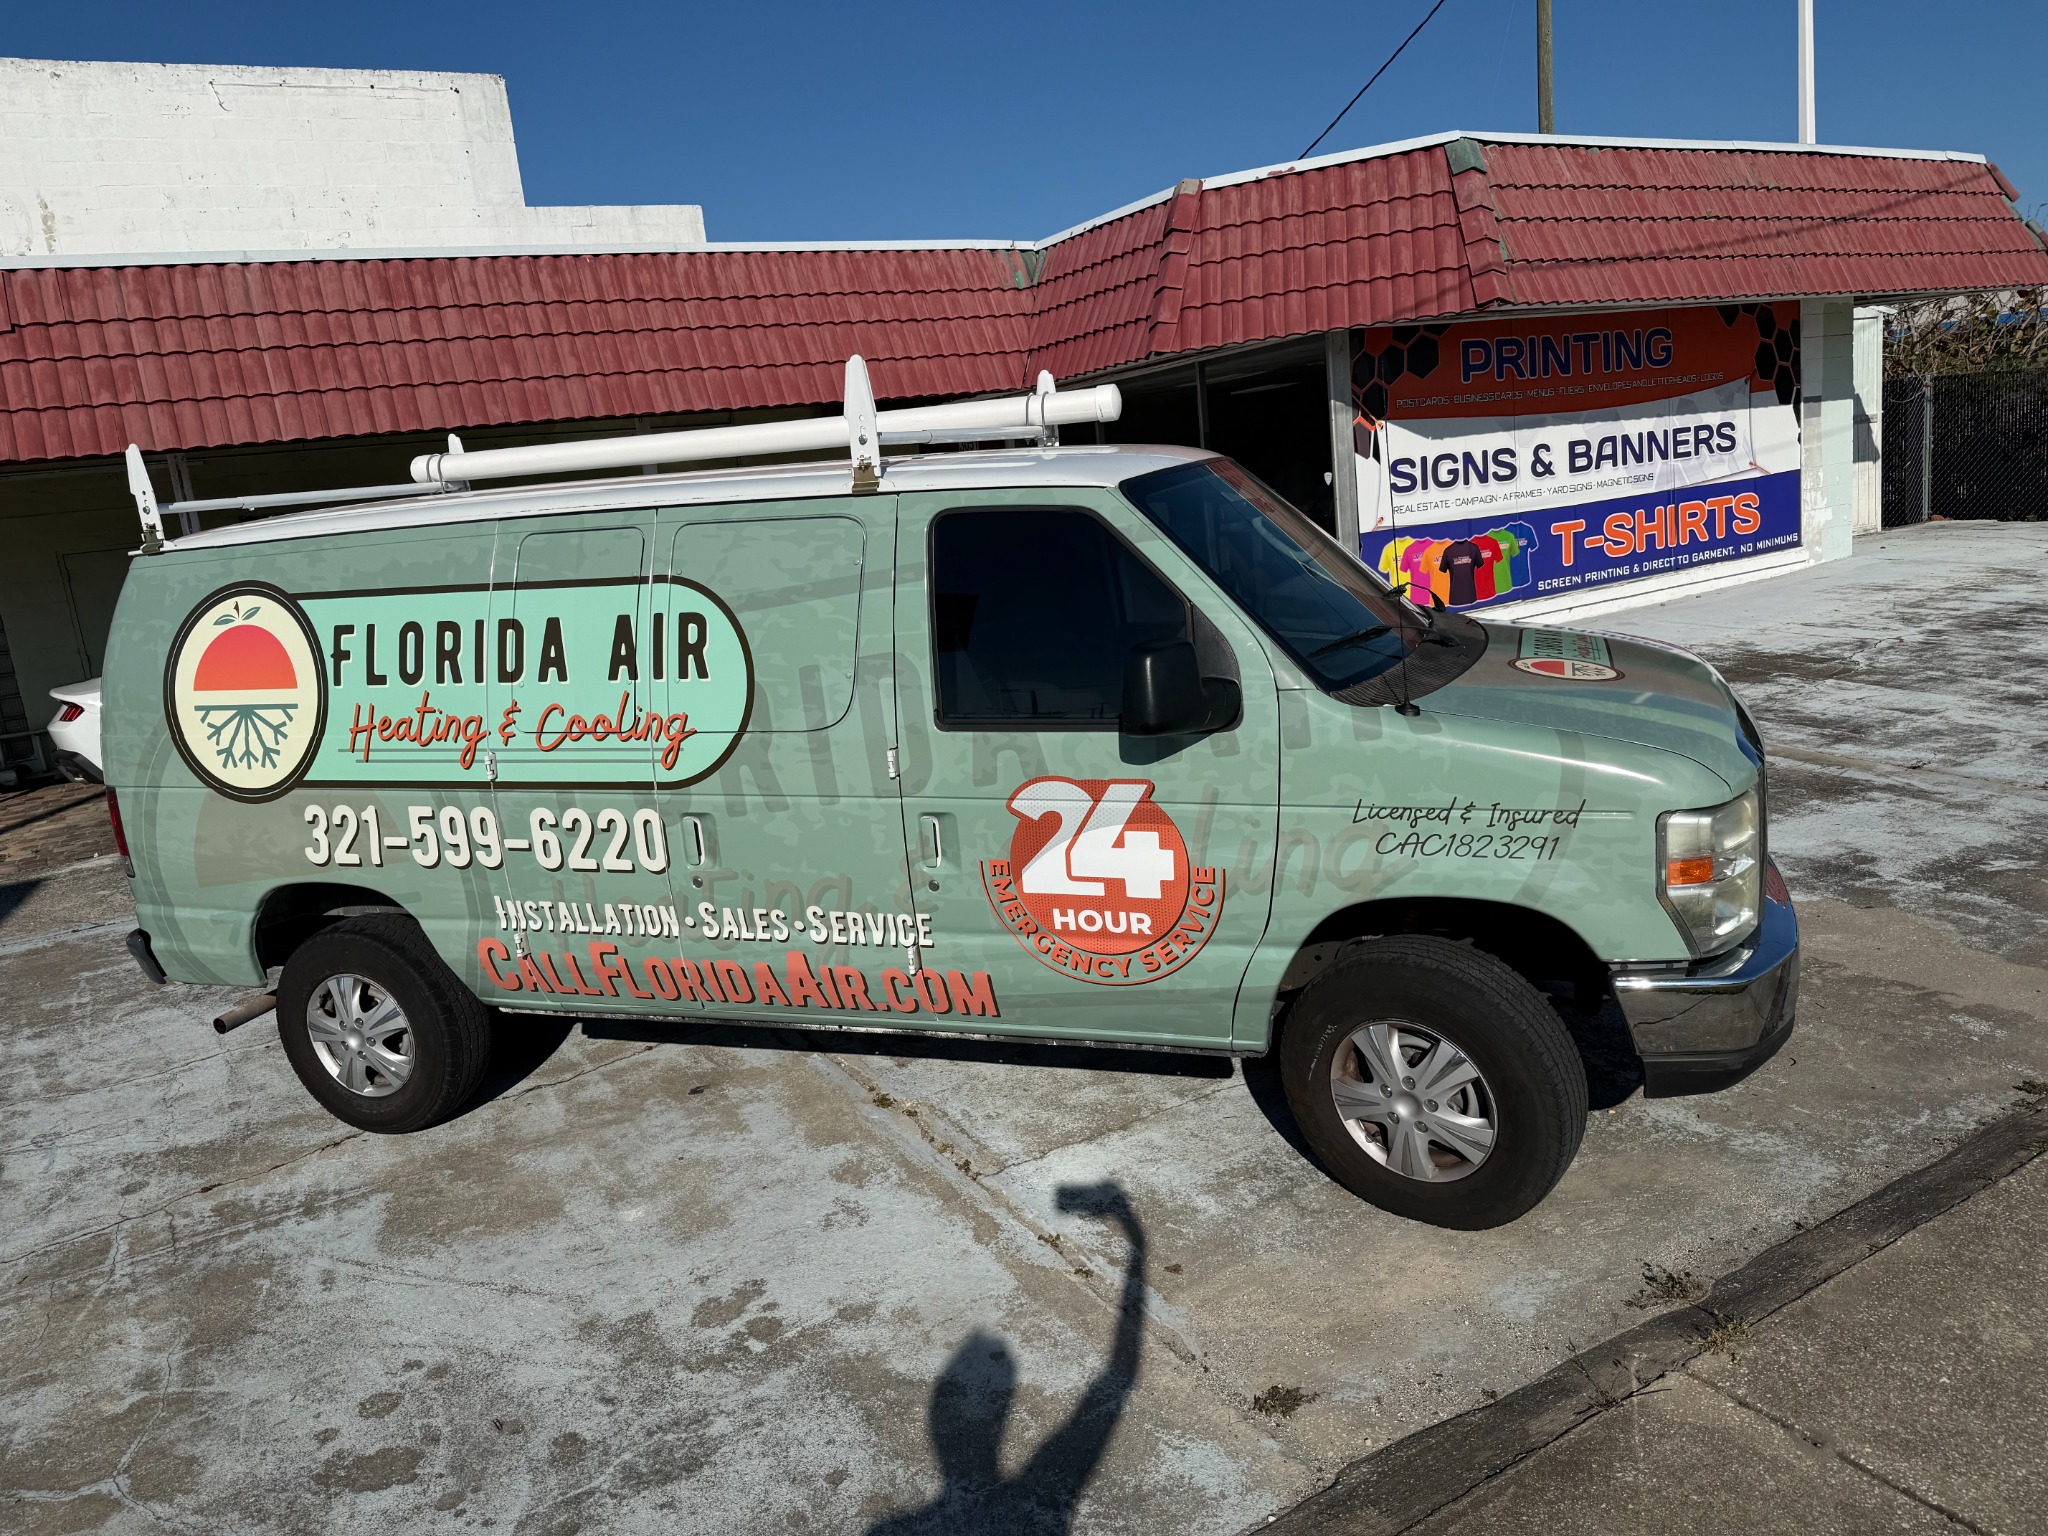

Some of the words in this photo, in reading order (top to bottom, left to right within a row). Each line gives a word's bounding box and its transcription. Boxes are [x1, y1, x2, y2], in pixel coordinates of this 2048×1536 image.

[1460, 327, 1673, 384] PRINTING
[1527, 387, 1555, 398] MENUS
[1700, 372, 1724, 382] LOGOS
[1390, 446, 1518, 494] SIGNS
[1530, 443, 1556, 478] &
[1567, 421, 1738, 474] BANNERS
[1455, 495, 1497, 507] CAMPAIGN
[1551, 492, 1761, 567] T-SHIRTS
[1537, 575, 1581, 590] SCREEN
[1585, 566, 1630, 582] PRINTING
[1633, 564, 1640, 573] &
[1642, 557, 1674, 571] DIRECT
[1677, 554, 1689, 564] TO
[1692, 546, 1735, 562] GARMENT.
[1740, 543, 1753, 554] NO
[1756, 533, 1798, 550] MINIMUMS
[330, 616, 569, 688] FLORIDA
[608, 612, 710, 686] AIR
[348, 690, 491, 770] Heating
[498, 699, 521, 746] &
[535, 690, 697, 770] Cooling
[304, 804, 671, 875] 321-599-6220
[1008, 779, 1175, 900] 24
[1352, 796, 1457, 829] Licensed
[1460, 801, 1476, 824] &
[1486, 798, 1586, 832] Insured
[1375, 832, 1561, 861] CAC1823291
[494, 895, 680, 939] INSTALLATION
[700, 901, 789, 944] SALES
[806, 905, 935, 949] SERVICE
[988, 859, 1132, 978] EMERGENCY
[1142, 865, 1216, 974] SERVICE
[1052, 908, 1152, 935] HOUR
